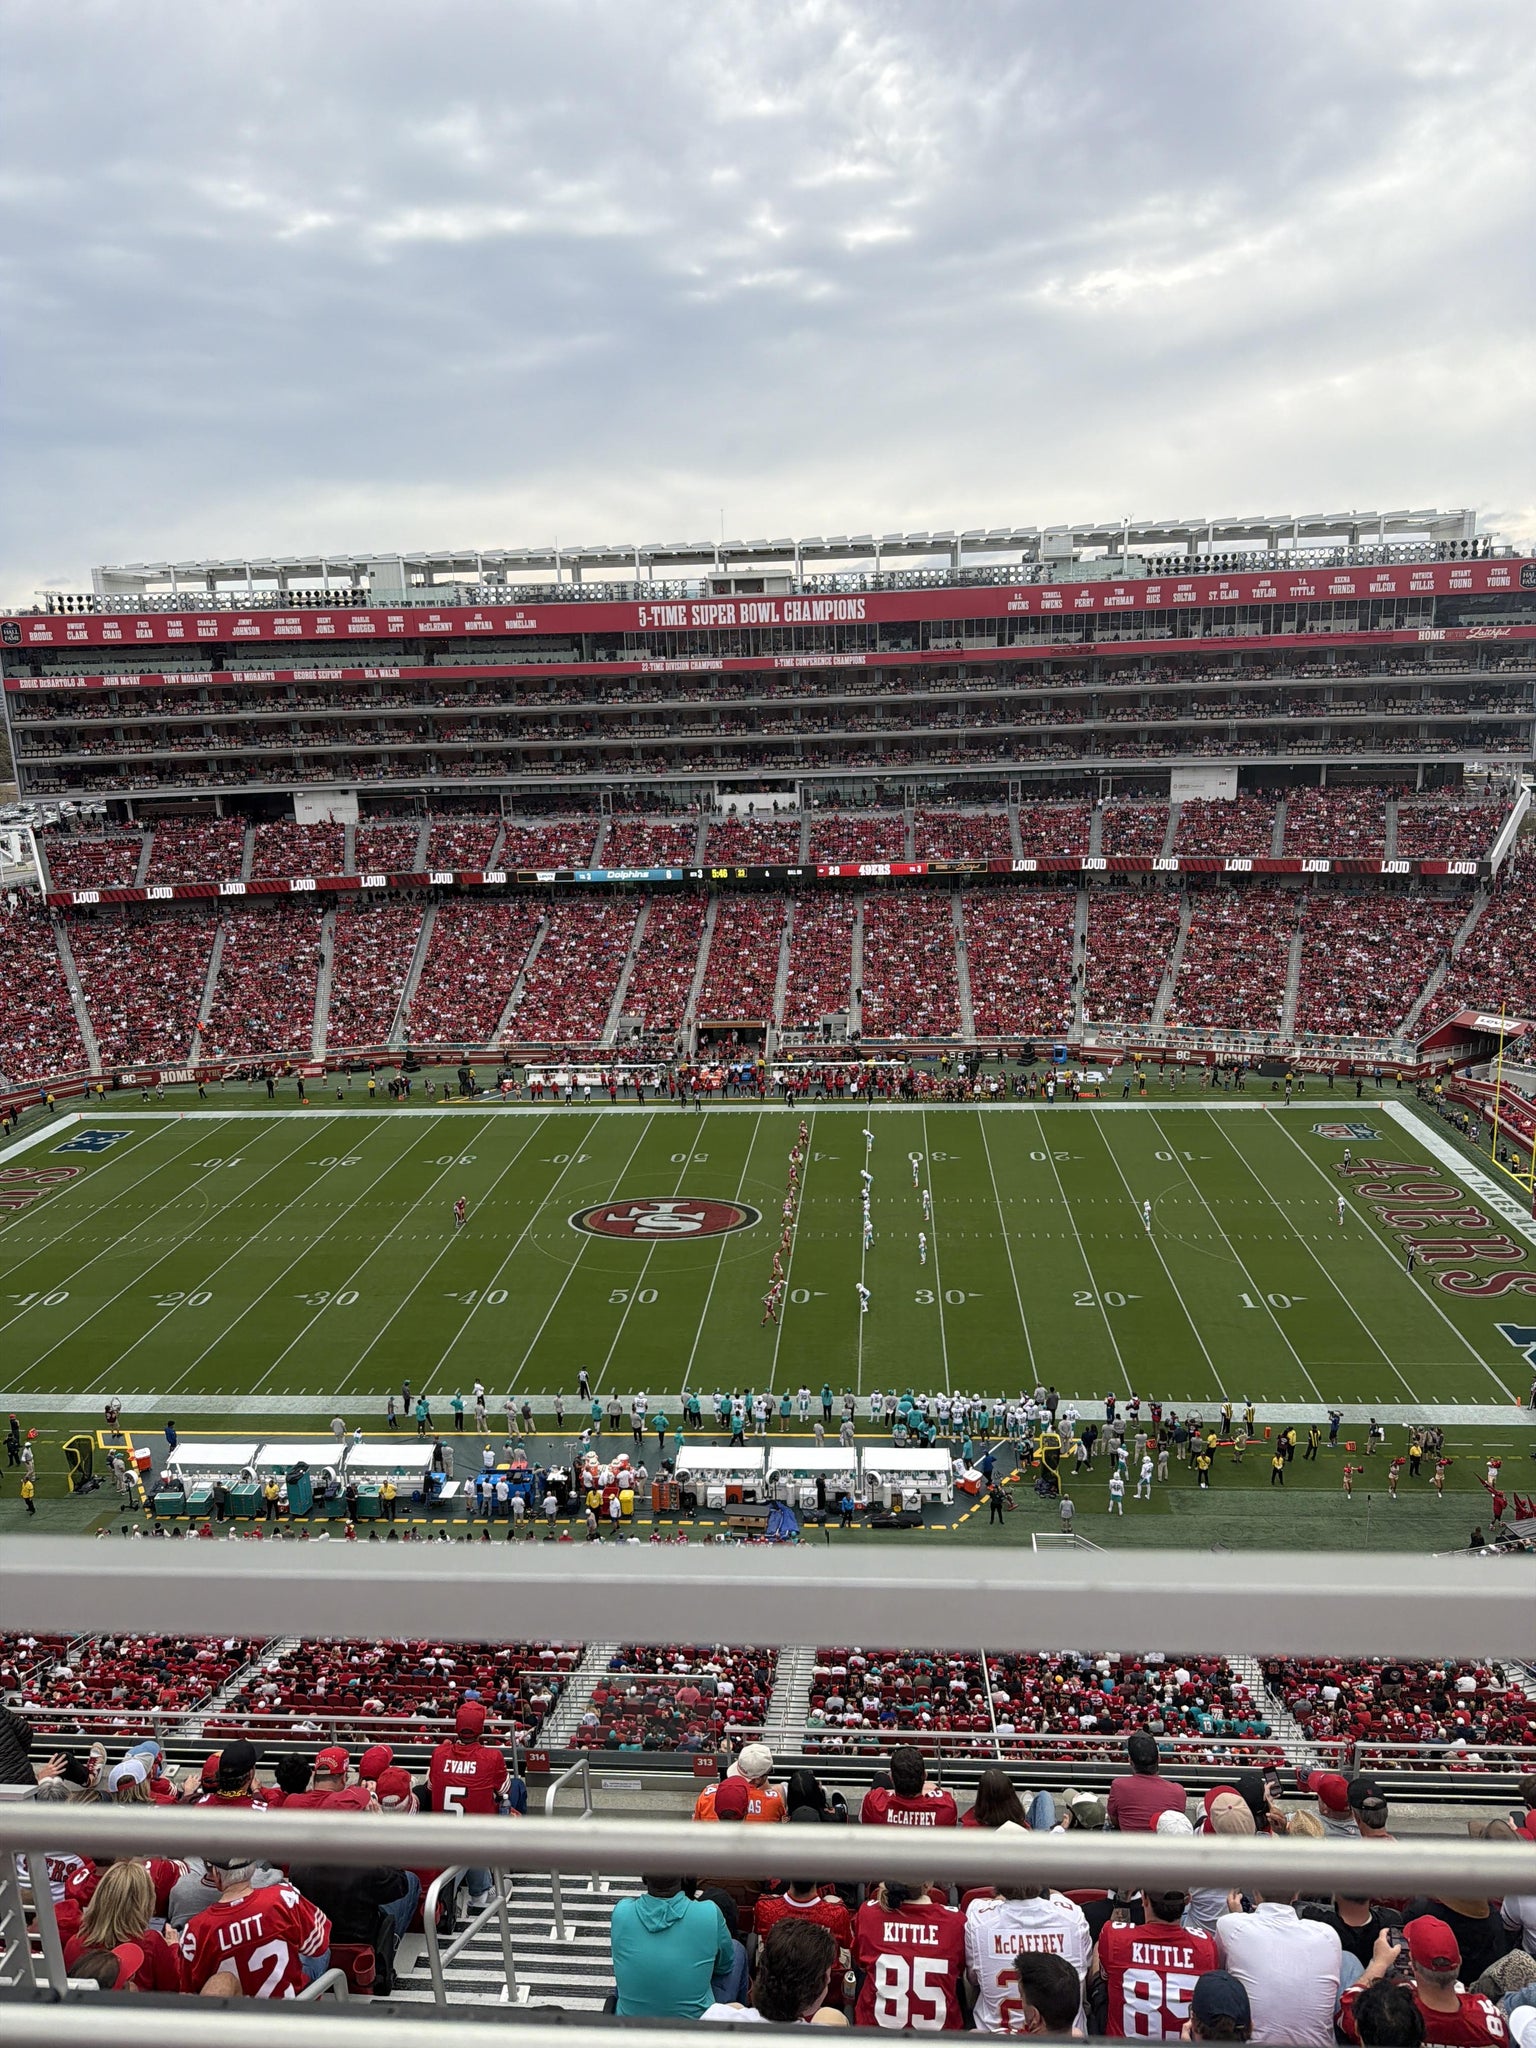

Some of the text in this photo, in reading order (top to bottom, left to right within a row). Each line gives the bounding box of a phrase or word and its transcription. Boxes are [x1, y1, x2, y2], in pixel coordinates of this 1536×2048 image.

[1370, 582, 1396, 592] WILCOX
[1410, 580, 1434, 591] WILLIS
[1449, 578, 1472, 588] YOUNG
[1487, 576, 1510, 587] YOUNG
[1208, 590, 1239, 600] ST. CLAIR
[1252, 588, 1277, 598] TAYLOR
[1290, 586, 1315, 596] TITTLE
[1328, 584, 1355, 595] TURNER
[1104, 596, 1134, 606] RATHMAN
[1146, 594, 1161, 604] RICE
[1173, 592, 1196, 602] SOLTAU
[1008, 601, 1029, 611] OWENS
[1041, 600, 1062, 610] OWENS
[1074, 598, 1095, 608] PERRY
[638, 598, 866, 627] 5-TIME SUPER BOWL CHAMPIONS
[316, 624, 335, 634] JONES
[348, 624, 376, 633] KRUEGER
[388, 623, 404, 632] LOTT
[418, 622, 452, 632] McELHENNY
[465, 621, 493, 631] MONTANA
[505, 620, 537, 629] NOMELLINI
[67, 630, 88, 640] CLARK
[102, 630, 122, 639] CRAIG
[136, 630, 153, 639] DEAN
[168, 628, 184, 638] GORE
[198, 628, 218, 637] HALEY
[232, 626, 260, 636] JOHNSON
[274, 626, 302, 635] JOHNSON
[1418, 630, 1445, 640] HOME
[1466, 628, 1511, 639] Faithful
[29, 632, 53, 641] BRODIE
[642, 661, 723, 671] 22-TIME DIVISION CHAMPIONS
[796, 657, 832, 666] CONFERENCE
[834, 656, 866, 665] CHAMPIONS
[163, 674, 212, 684] TONY MORABITO
[232, 672, 275, 681] VIC MORABITO
[294, 670, 342, 680] GEORGE SEIFERT
[365, 669, 400, 678] BILL WALSH
[20, 680, 38, 689] EDDIE
[77, 678, 87, 687] JR.
[103, 677, 140, 686] JOHN McVAY
[1012, 860, 1037, 872] LOUD
[1082, 858, 1107, 870] LOUD
[1153, 858, 1178, 871] LOUD
[1225, 859, 1252, 871] LOUD
[1301, 860, 1330, 873] LOUD
[1381, 860, 1410, 874] LOUD
[1448, 861, 1477, 875] LOUD
[607, 870, 649, 880] Dolphins
[712, 869, 728, 878] 5:46
[858, 864, 891, 876] 49ERS
[361, 875, 386, 888] LOUD
[429, 872, 453, 885] LOUD
[482, 872, 506, 884] LOUD
[219, 882, 246, 896] LOUD
[290, 879, 316, 892] LOUD
[72, 891, 99, 904] LOUD
[146, 887, 173, 900] LOUD
[1284, 1056, 1339, 1072] Faithful
[160, 1069, 195, 1084] HOME
[1328, 1157, 1536, 1298] 49ERS
[12, 1292, 70, 1306] 10
[156, 1292, 213, 1306] 20
[306, 1290, 360, 1306] 30
[456, 1289, 509, 1305] 40
[608, 1288, 659, 1304] 50
[915, 1289, 966, 1305] 30
[1072, 1290, 1127, 1307] 20
[1238, 1293, 1292, 1309] 10
[1203, 1721, 1212, 1731] 13
[530, 1754, 546, 1762] 314
[697, 1758, 713, 1766] 313
[444, 1760, 477, 1775] EVANS
[443, 1786, 466, 1816] 5
[887, 1810, 937, 1826] McCAFFREY
[218, 1913, 263, 1951] LOTT
[884, 1922, 939, 1945] KITTLE
[994, 1934, 1065, 1955] McCAFFREY
[1132, 1942, 1194, 1969] KITTLE
[875, 1954, 949, 2031] 85
[1122, 1968, 1200, 2041] 85
